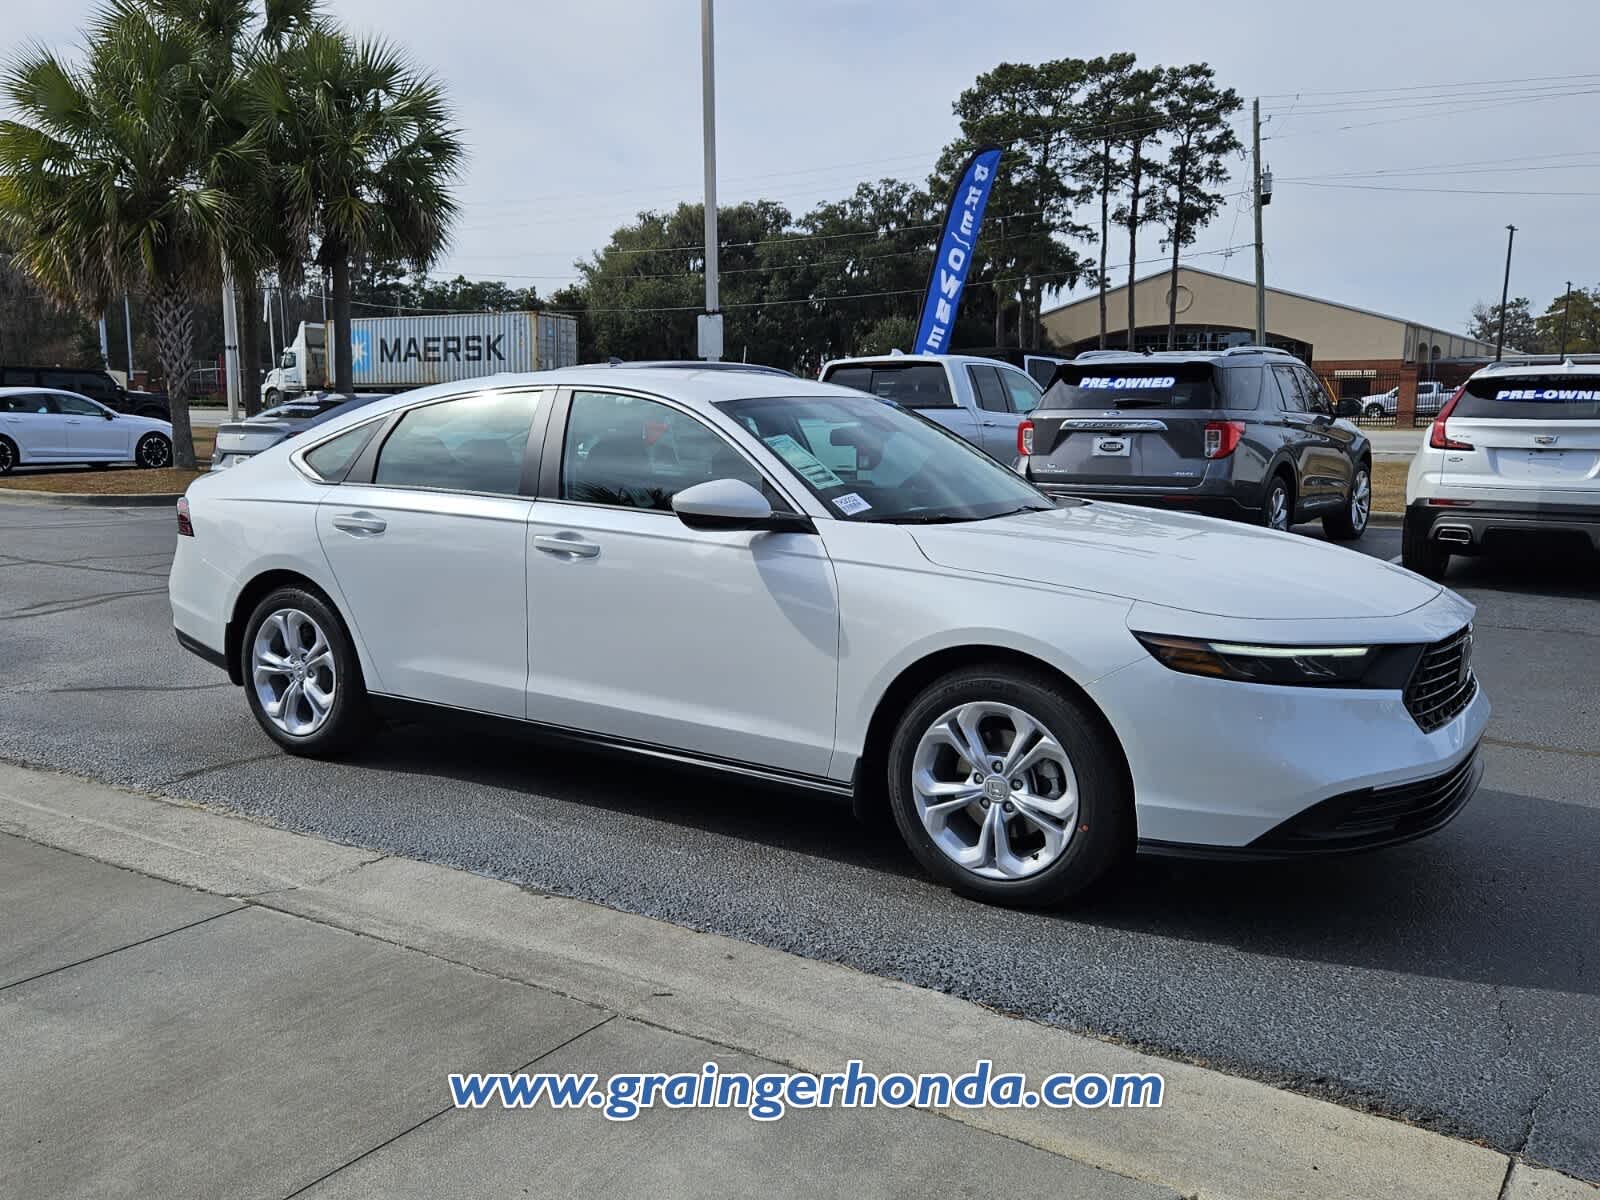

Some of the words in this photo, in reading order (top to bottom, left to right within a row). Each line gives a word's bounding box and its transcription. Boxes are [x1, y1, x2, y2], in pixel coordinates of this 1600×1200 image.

[922, 163, 990, 355] PRE-OWNE
[379, 333, 506, 363] MAERSK
[1079, 376, 1176, 389] PRE-OWNED
